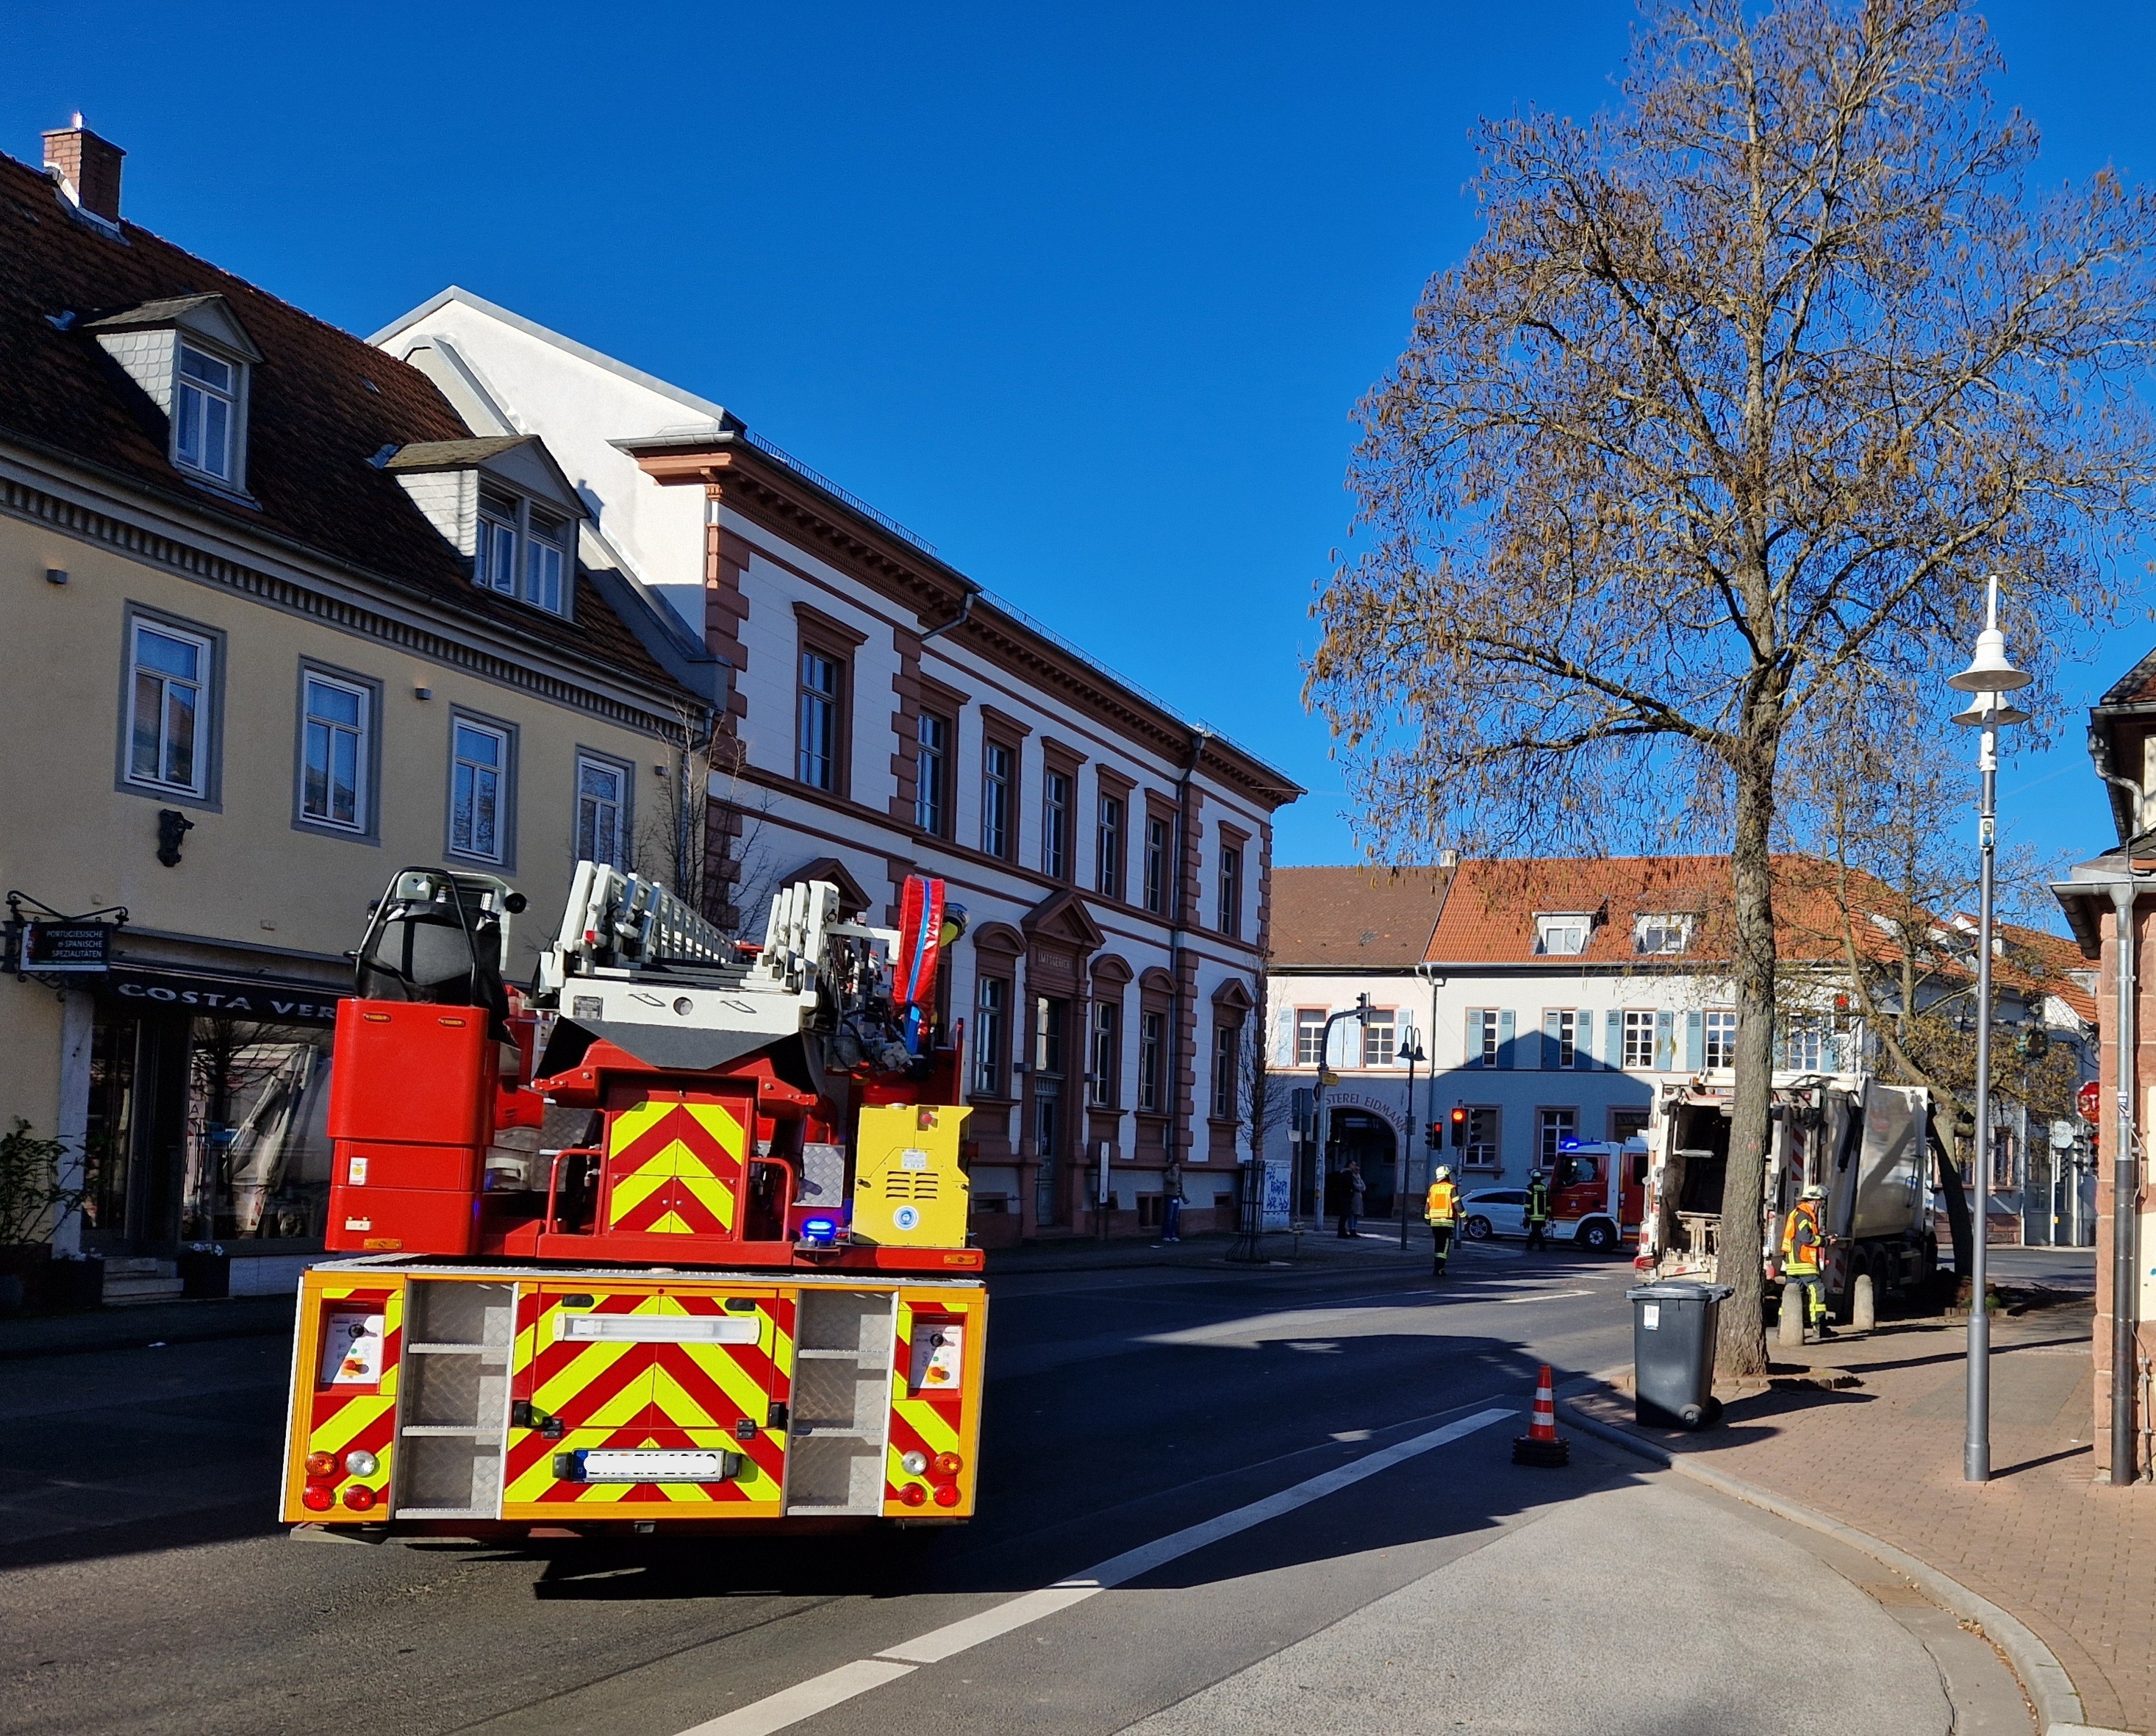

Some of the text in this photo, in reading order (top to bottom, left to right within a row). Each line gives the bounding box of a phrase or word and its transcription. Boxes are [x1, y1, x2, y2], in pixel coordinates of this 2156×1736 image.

[118, 983, 336, 1019] COSTA VER
[1364, 1096, 1407, 1133] EIDMANN
[2080, 1093, 2098, 1112] ST
